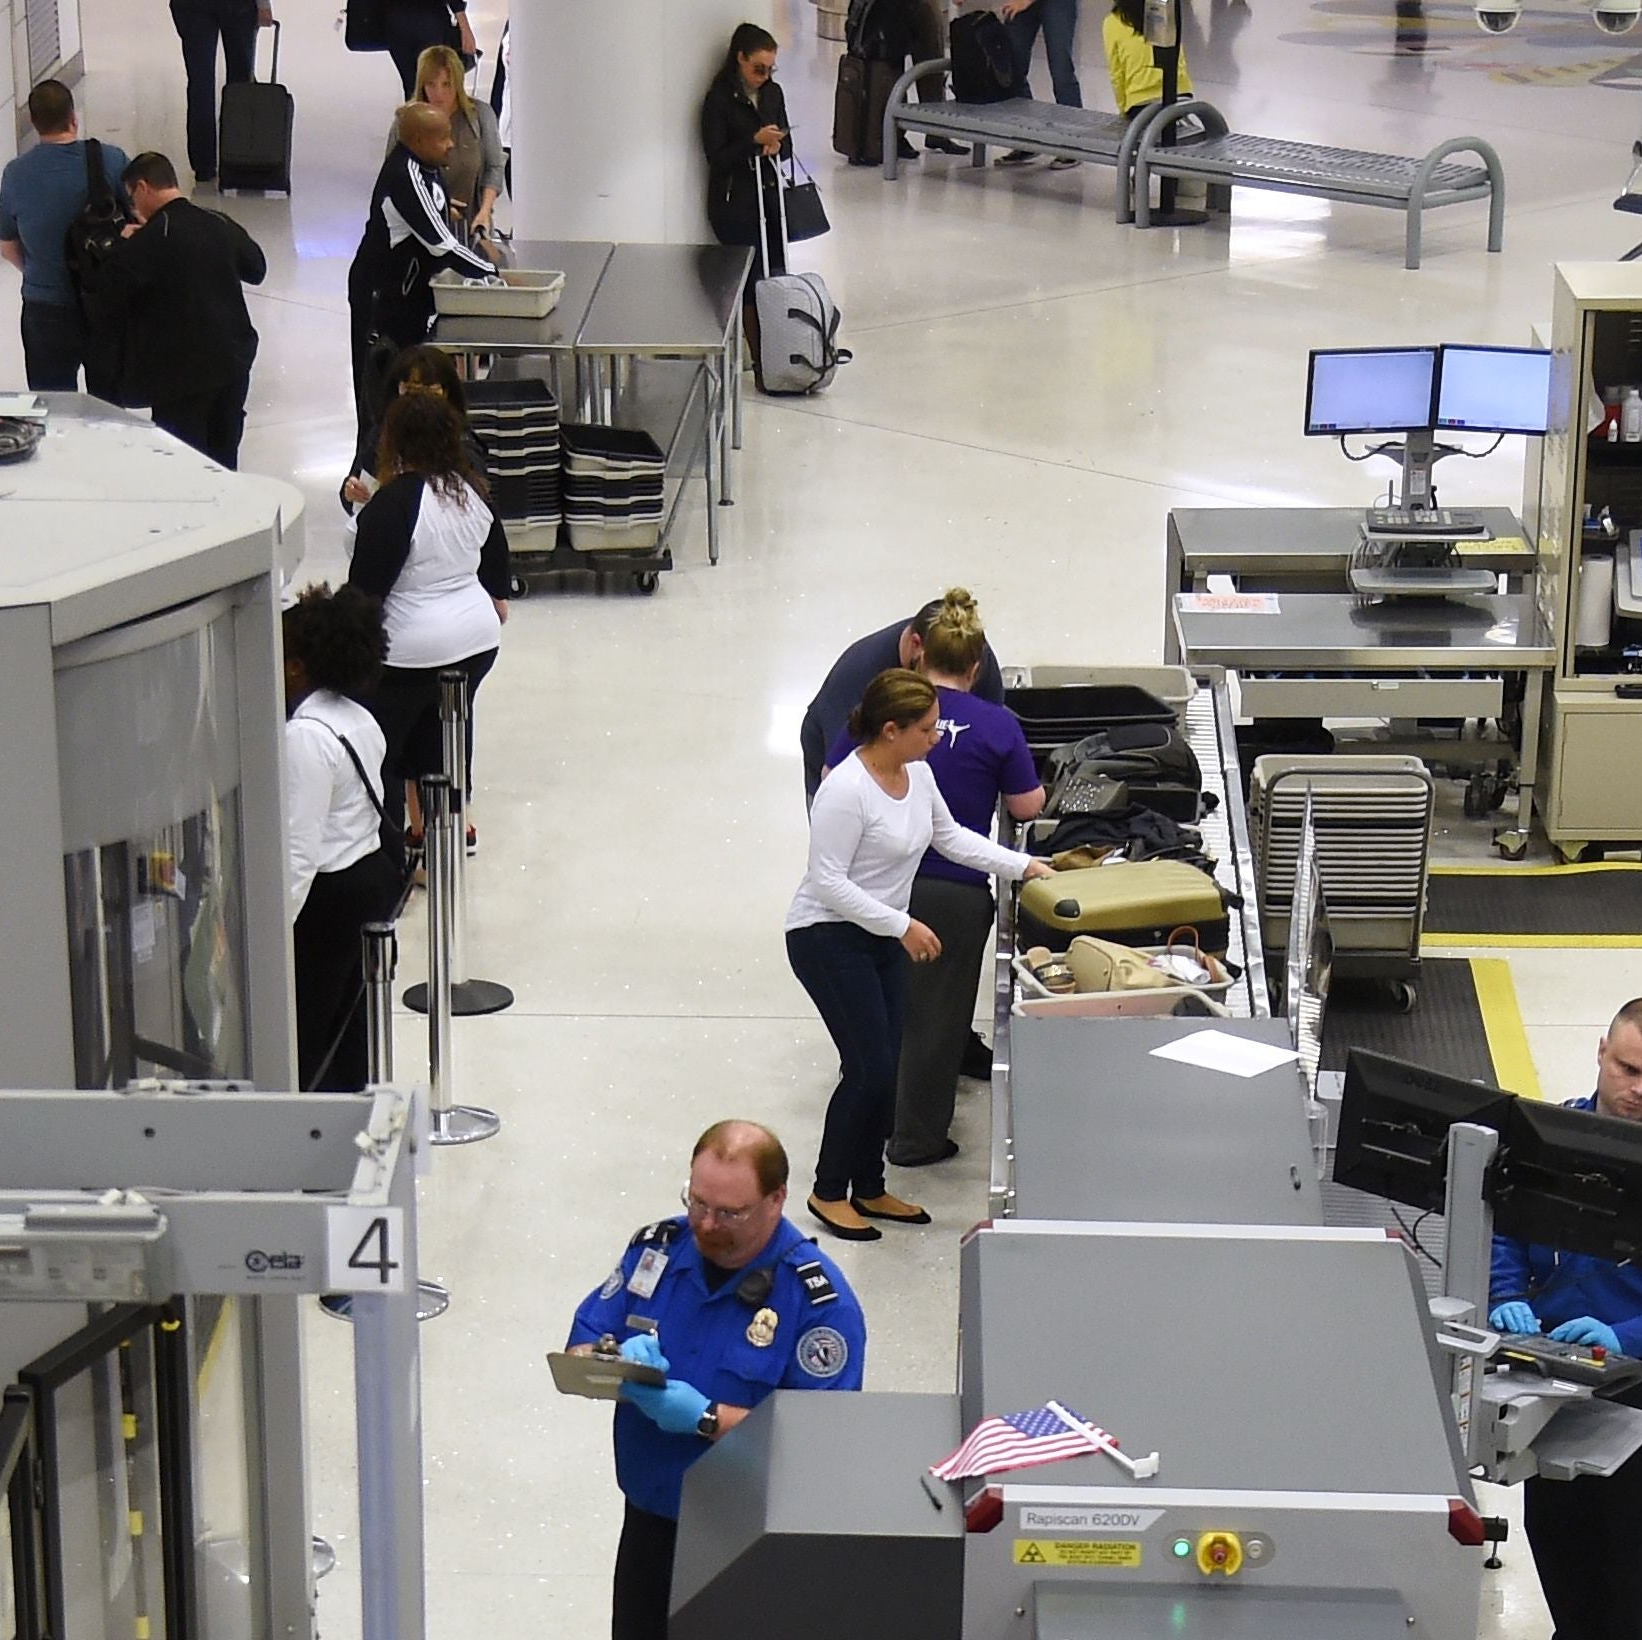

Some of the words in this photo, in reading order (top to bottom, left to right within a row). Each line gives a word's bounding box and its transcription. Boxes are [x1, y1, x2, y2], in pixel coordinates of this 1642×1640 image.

[348, 1217, 399, 1284] 4
[804, 1274, 829, 1290] TSA
[1026, 1512, 1088, 1527] Rapiscan
[1092, 1513, 1140, 1526] 620DV
